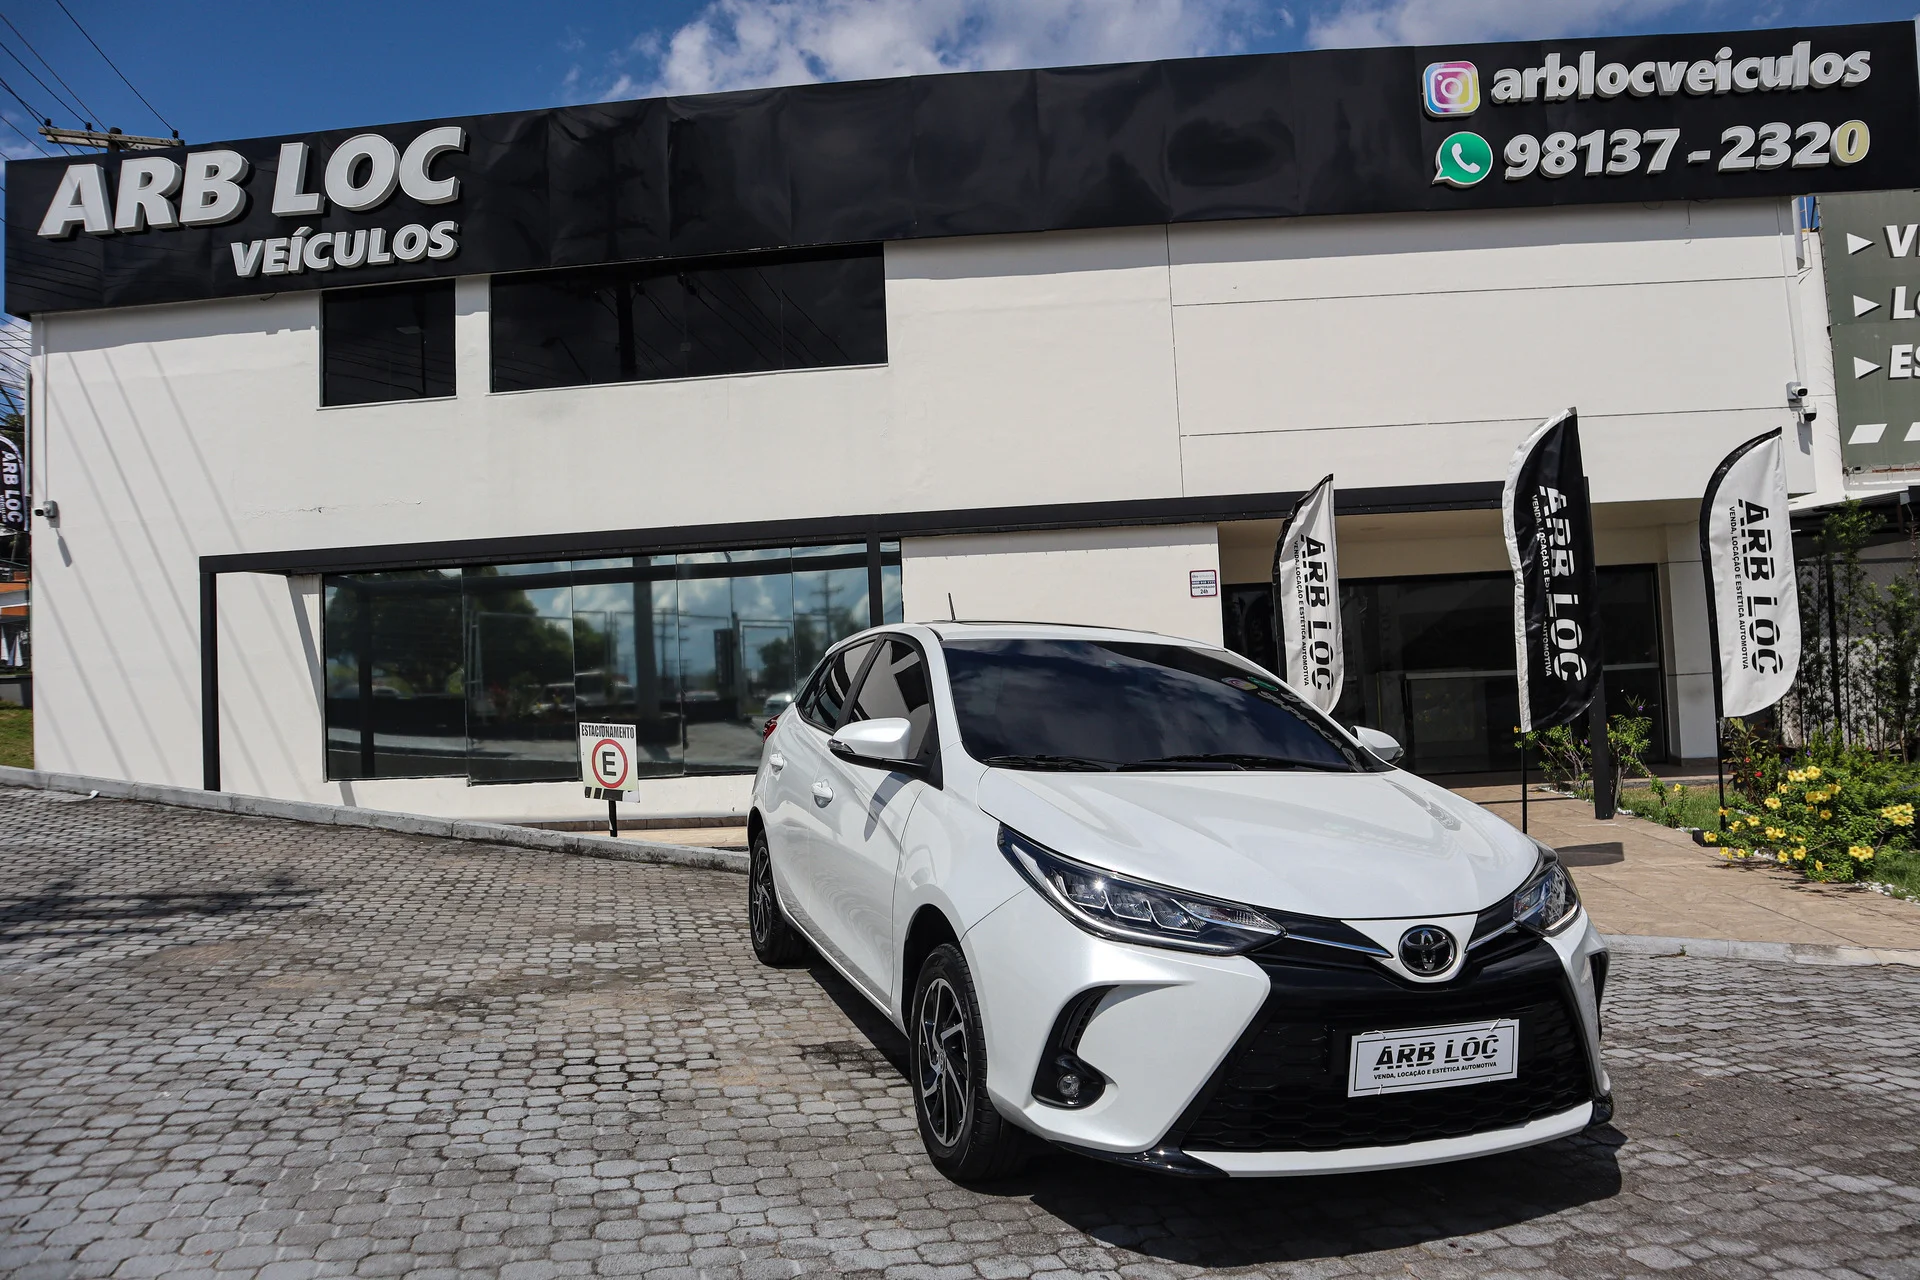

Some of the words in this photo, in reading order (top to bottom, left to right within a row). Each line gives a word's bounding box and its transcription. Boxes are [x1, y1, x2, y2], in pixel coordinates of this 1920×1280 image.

[1491, 41, 1871, 104] arblocveiculos
[37, 150, 249, 239] ARB
[272, 126, 466, 217] LOC
[231, 221, 459, 278] VEÍCULOS
[1, 450, 20, 486] ARB
[4, 489, 24, 523] LOC
[1729, 506, 1737, 534] VENDA,
[1539, 485, 1575, 577] ARB
[1731, 536, 1741, 572] LOCAÇÃO
[1738, 499, 1775, 581] ARB
[1300, 534, 1330, 607] ARB
[1736, 581, 1745, 618] ESTÉTICA
[1307, 621, 1334, 690] LOC
[1548, 593, 1588, 682] LOC
[1739, 620, 1749, 669] AUTOMOTIVA
[1747, 596, 1783, 674] LOC
[1302, 641, 1310, 686] AUTOMOTIVA
[581, 724, 635, 739] ESTACIONAMENTO
[602, 751, 617, 776] E
[1373, 1041, 1436, 1071] ARB
[1444, 1034, 1499, 1064] LOC
[1397, 1069, 1426, 1078] LOCAÇÃO
[1432, 1065, 1460, 1074] ESTÉTICA
[1461, 1061, 1497, 1071] AUTOMOTIVA
